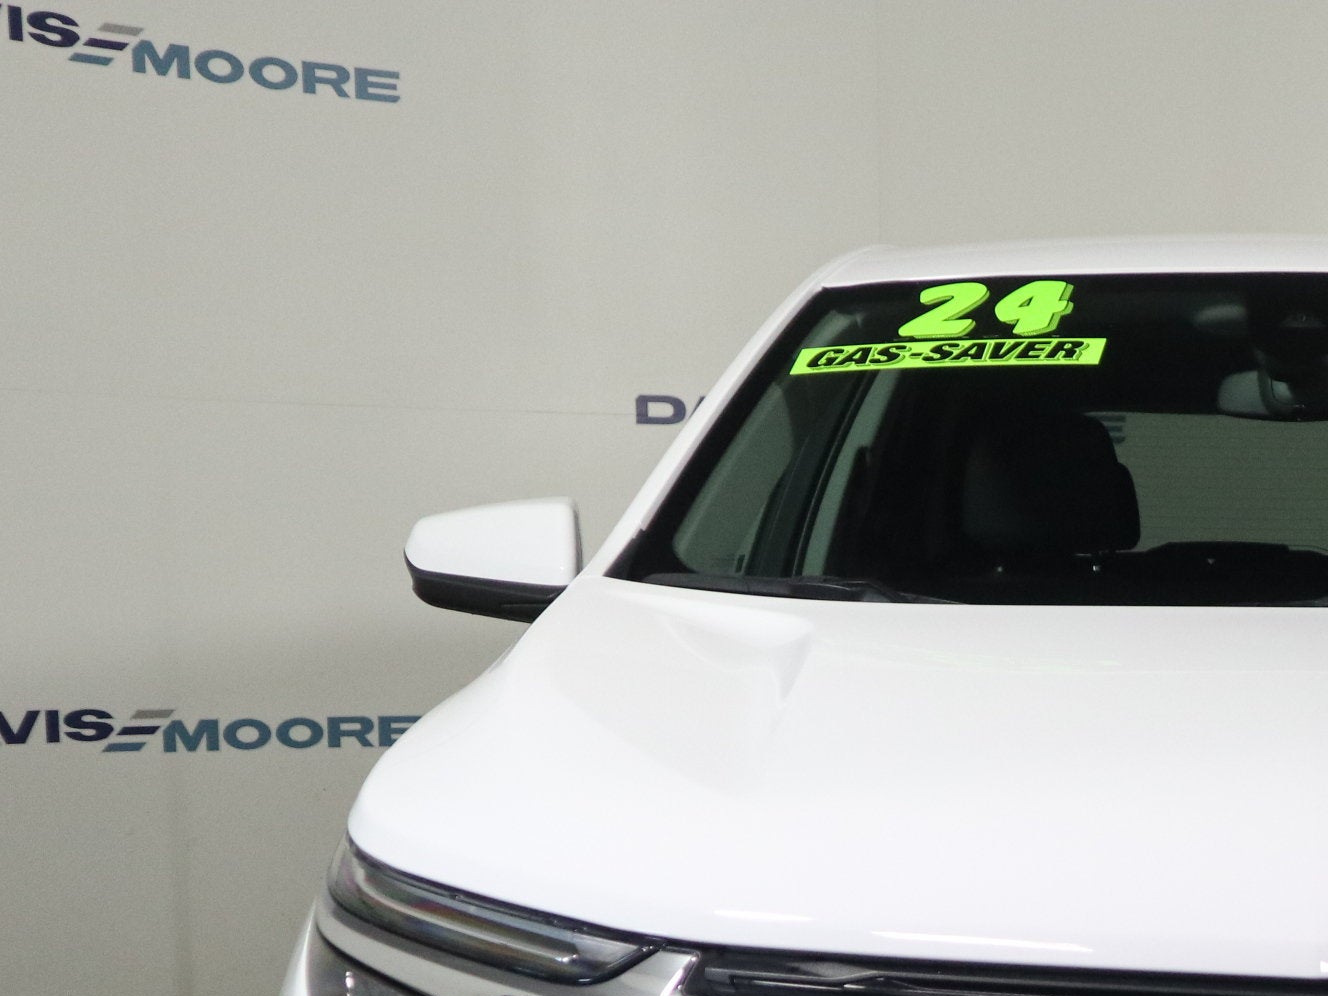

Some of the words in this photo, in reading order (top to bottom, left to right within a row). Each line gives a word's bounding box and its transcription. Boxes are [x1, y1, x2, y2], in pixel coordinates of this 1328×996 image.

[0, 3, 81, 48] IS
[132, 39, 401, 103] MOORE
[898, 279, 1075, 338] 24
[806, 340, 1091, 370] GAS-SAVER
[162, 715, 423, 753] MOORE
